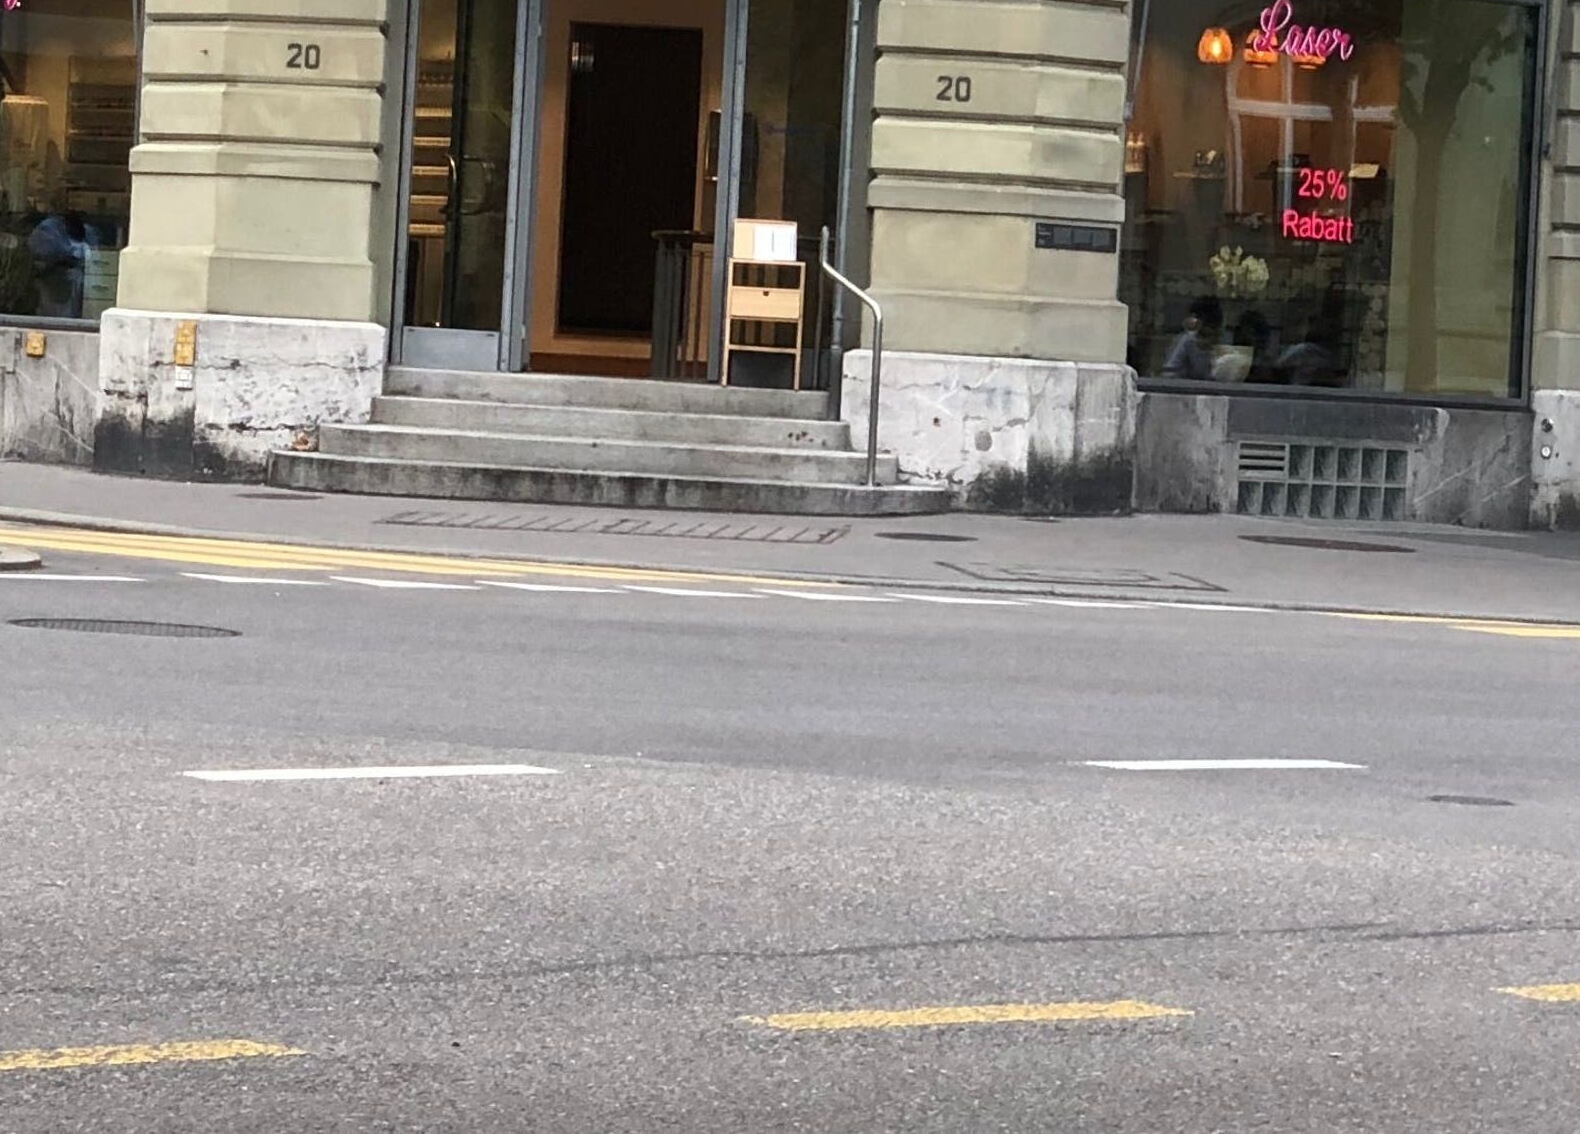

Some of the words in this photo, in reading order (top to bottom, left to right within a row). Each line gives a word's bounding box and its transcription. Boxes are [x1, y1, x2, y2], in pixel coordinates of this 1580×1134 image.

[286, 43, 320, 69] 20
[936, 76, 971, 102] 20
[1299, 168, 1347, 200] 25%
[1283, 209, 1353, 244] Rabatt
